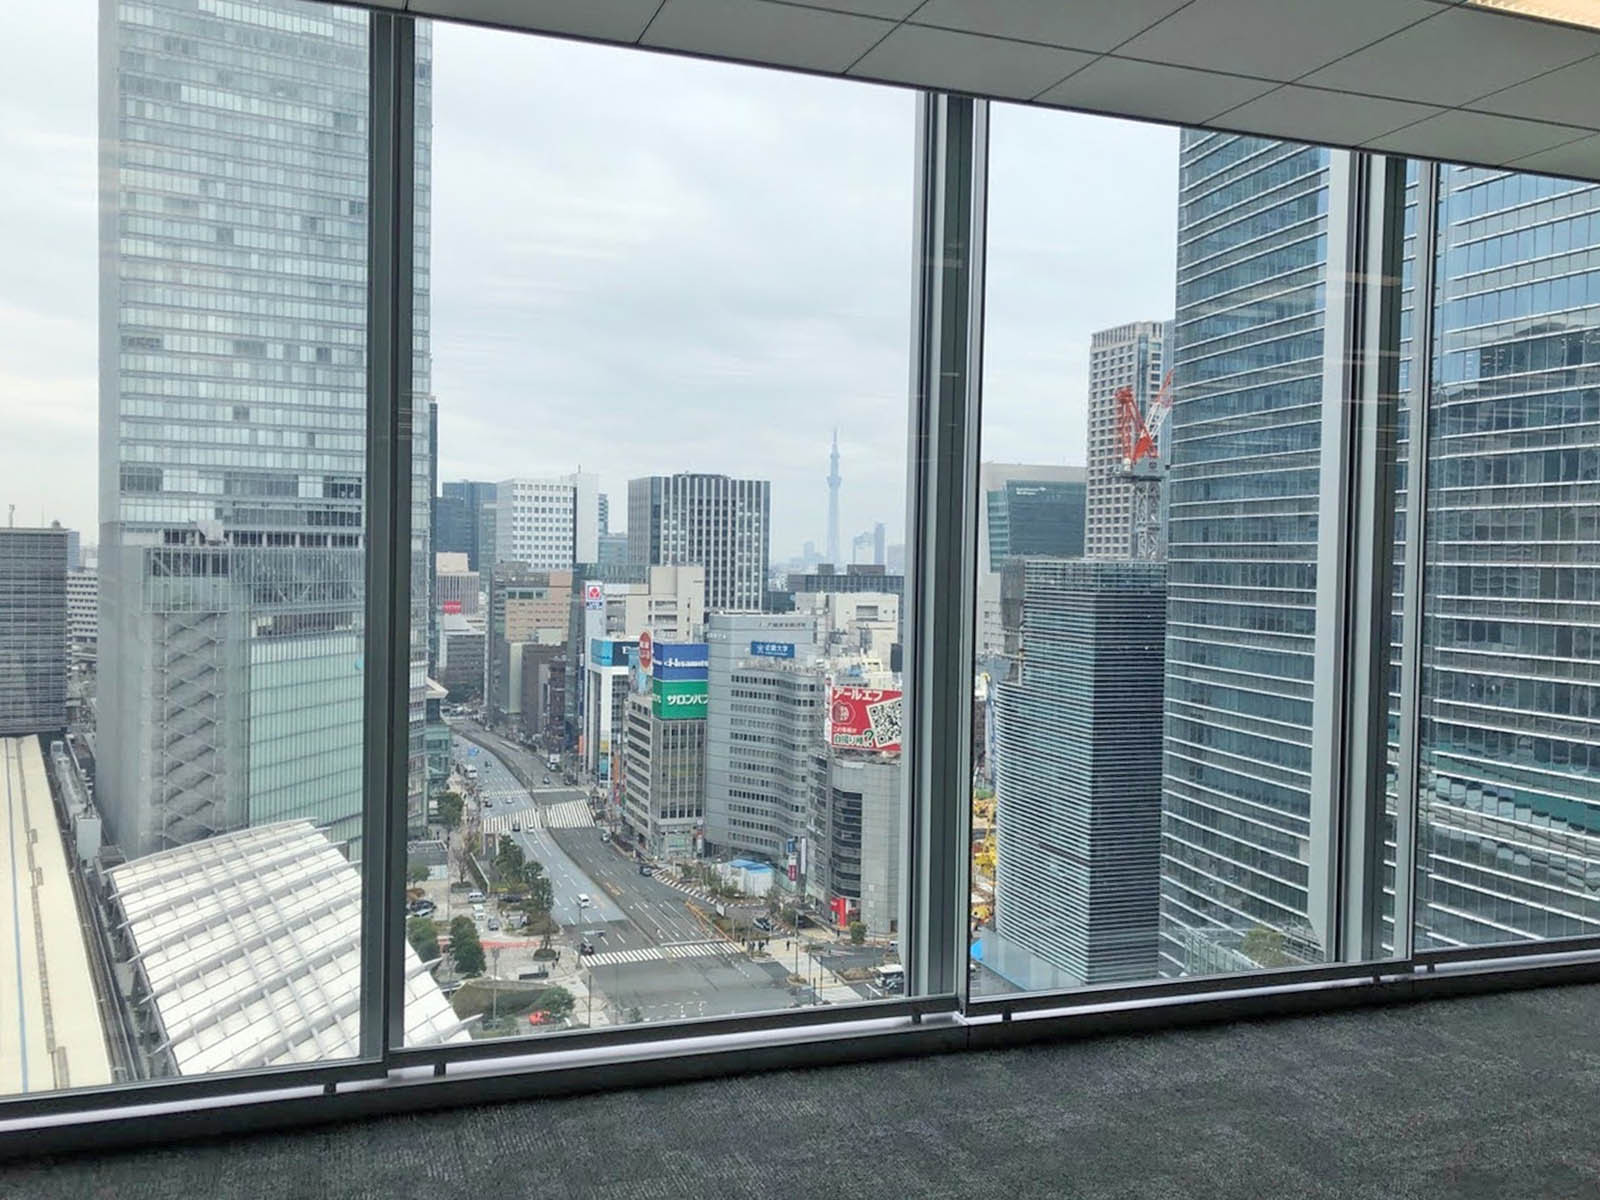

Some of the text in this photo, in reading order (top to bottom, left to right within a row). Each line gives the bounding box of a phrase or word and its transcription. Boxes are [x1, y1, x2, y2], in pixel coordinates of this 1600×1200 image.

[834, 687, 883, 701] アールエフ
